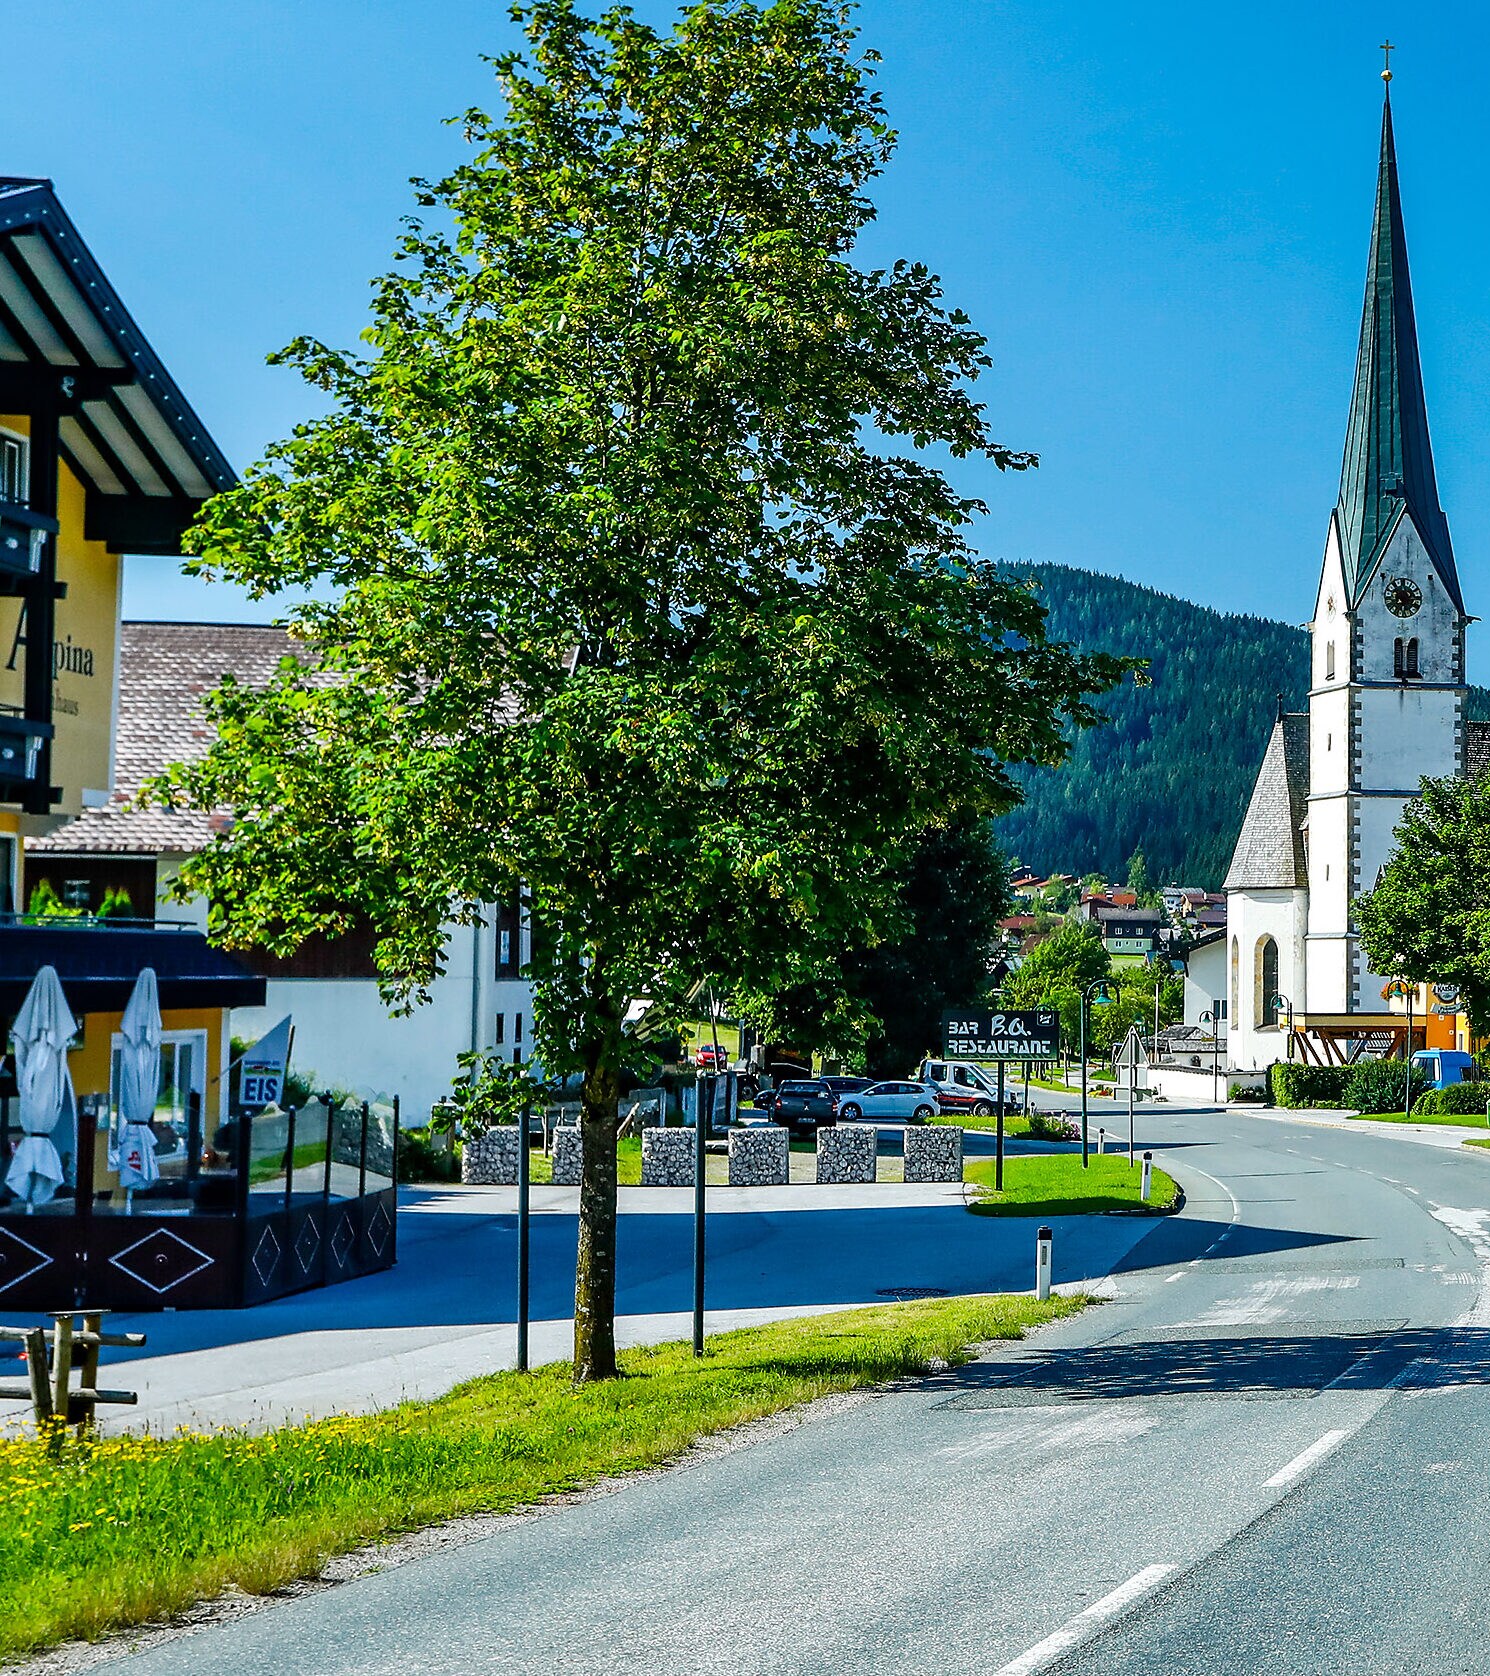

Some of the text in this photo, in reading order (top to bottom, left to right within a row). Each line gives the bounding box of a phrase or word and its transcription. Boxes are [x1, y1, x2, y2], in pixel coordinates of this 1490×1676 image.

[5, 597, 94, 680] Apina
[948, 1021, 979, 1035] BAR
[948, 1039, 1051, 1054] RESTAURANT
[244, 1078, 278, 1102] EIS
